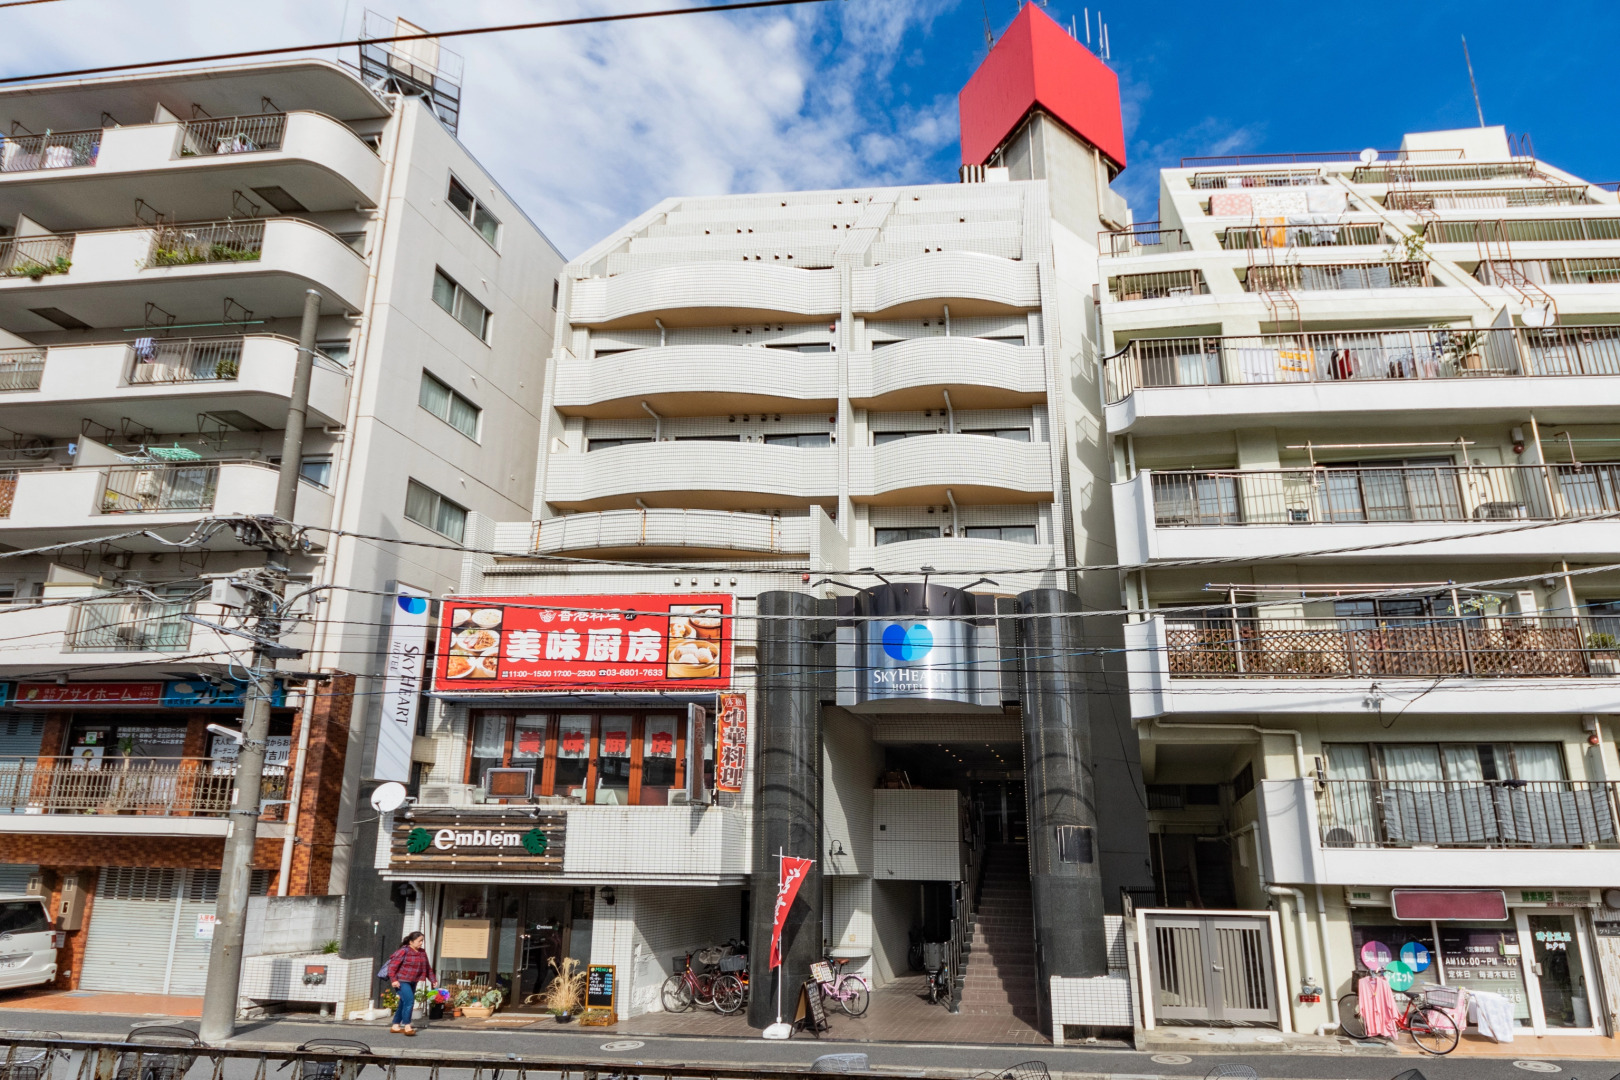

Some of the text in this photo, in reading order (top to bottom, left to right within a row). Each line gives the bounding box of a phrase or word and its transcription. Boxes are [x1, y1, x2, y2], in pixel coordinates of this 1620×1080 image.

[558, 608, 621, 622] 香港料理
[505, 628, 662, 663] 美味厨房
[606, 668, 663, 677] 03-6801-7633
[57, 688, 132, 701] アサイホーム
[518, 731, 673, 754] 美味厨房
[721, 707, 746, 788] 中華料理
[434, 829, 521, 850] emblem
[1448, 970, 1471, 979] 定休日
